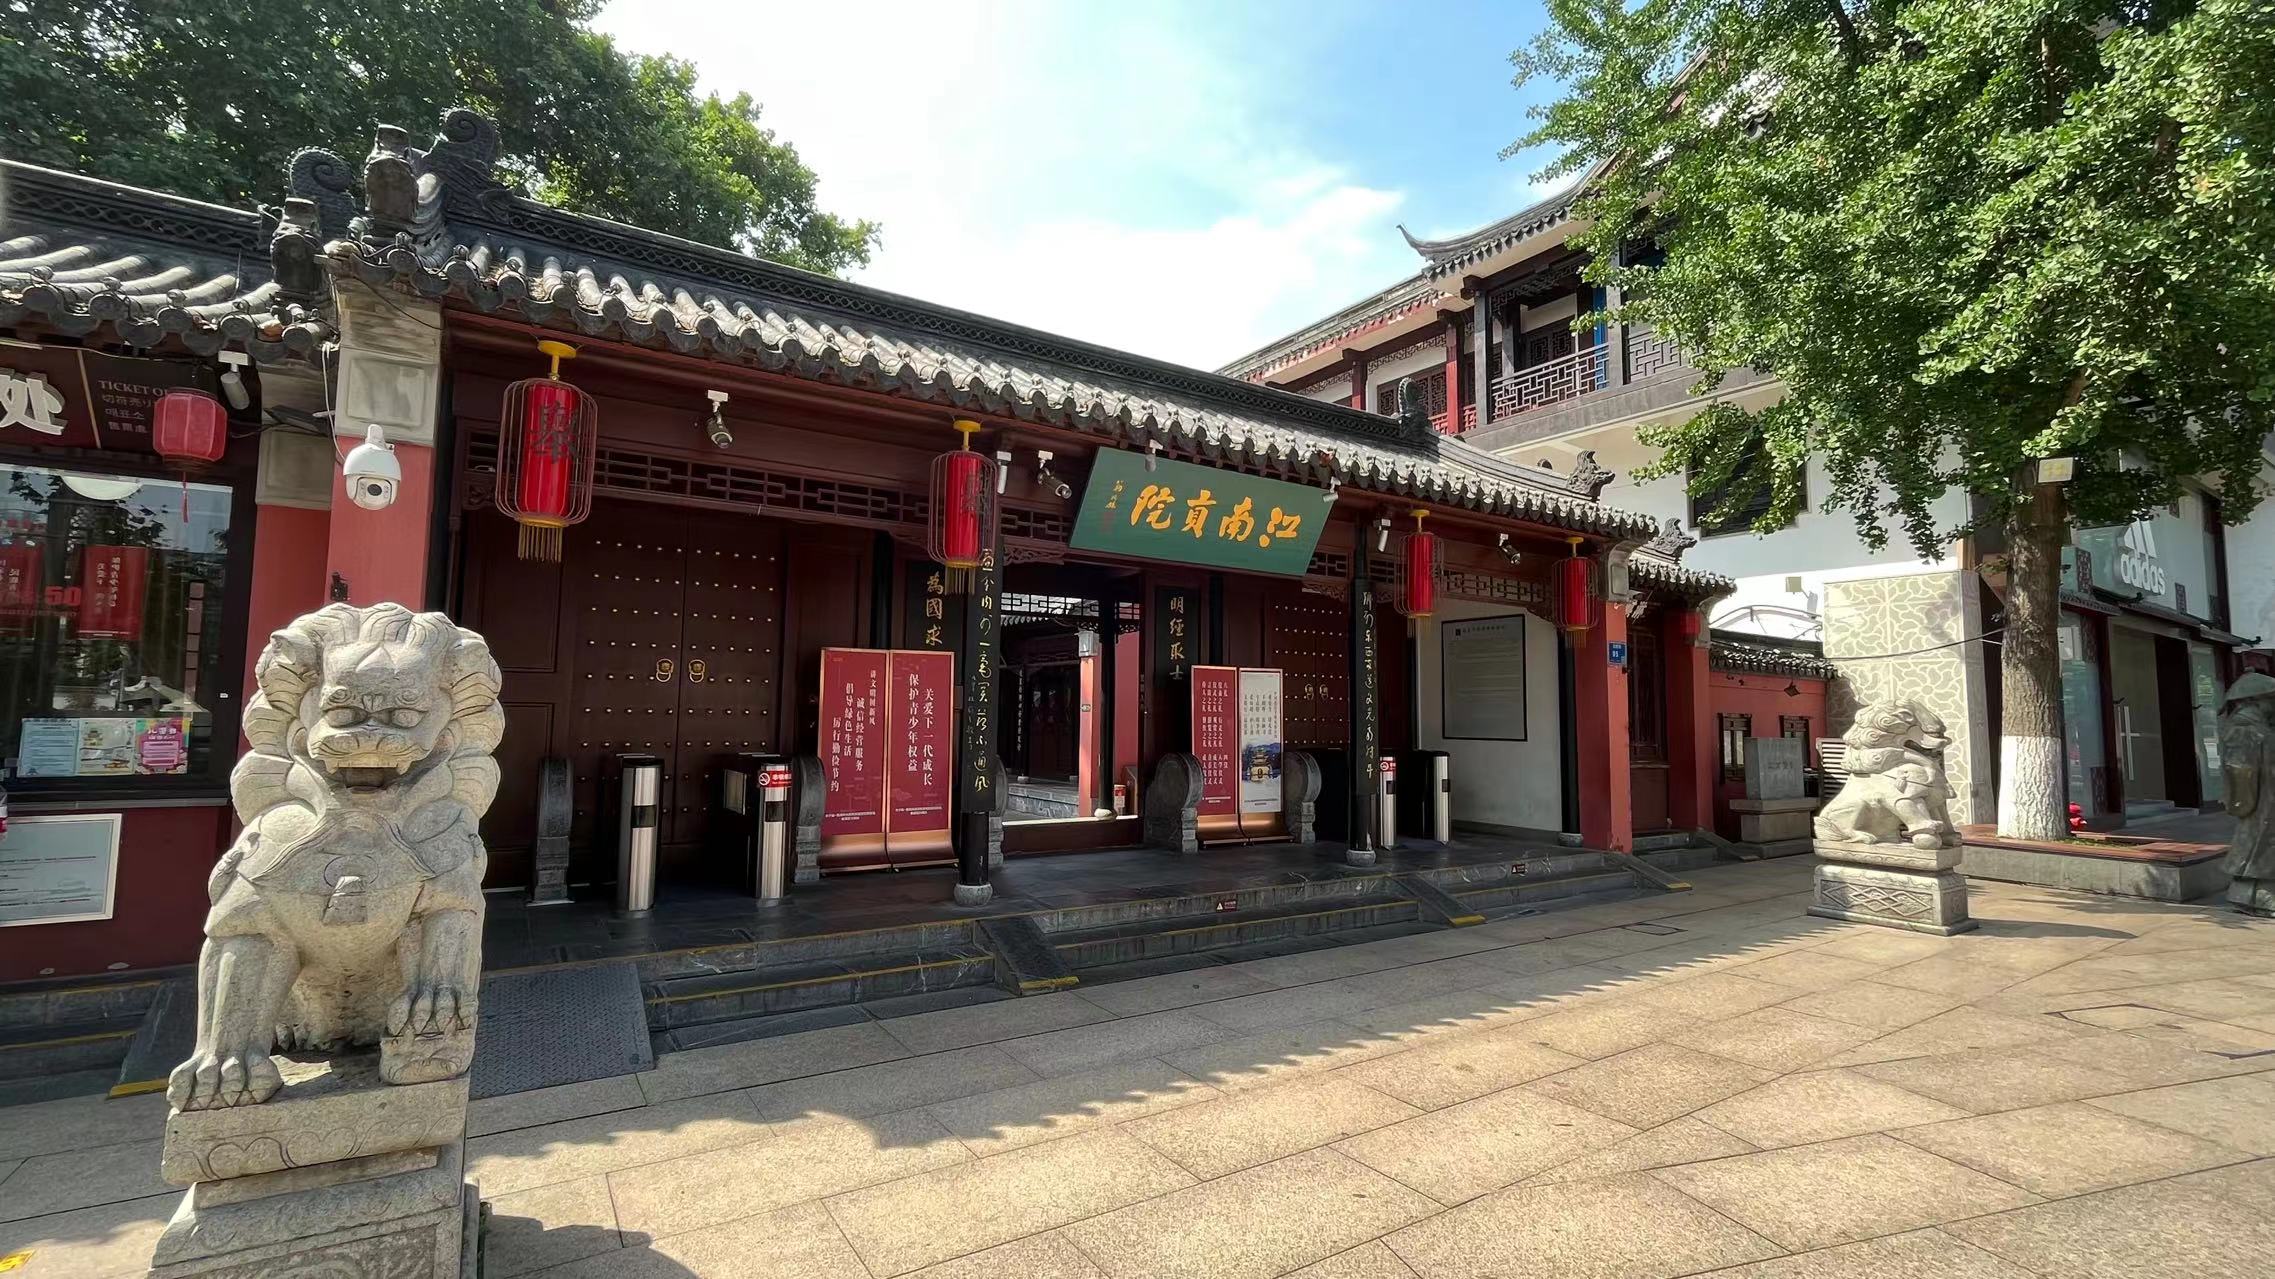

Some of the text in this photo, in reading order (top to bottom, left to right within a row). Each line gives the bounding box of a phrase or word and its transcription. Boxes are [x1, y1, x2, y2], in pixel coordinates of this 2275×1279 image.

[98, 379, 150, 396] TICKET
[2121, 549, 2166, 595] adidas
[843, 683, 854, 757] 倡导绿色生活
[855, 697, 866, 772] 诚信经营服务
[908, 673, 920, 772] 保护青少年权益
[922, 688, 934, 786] 关爱下一代成长
